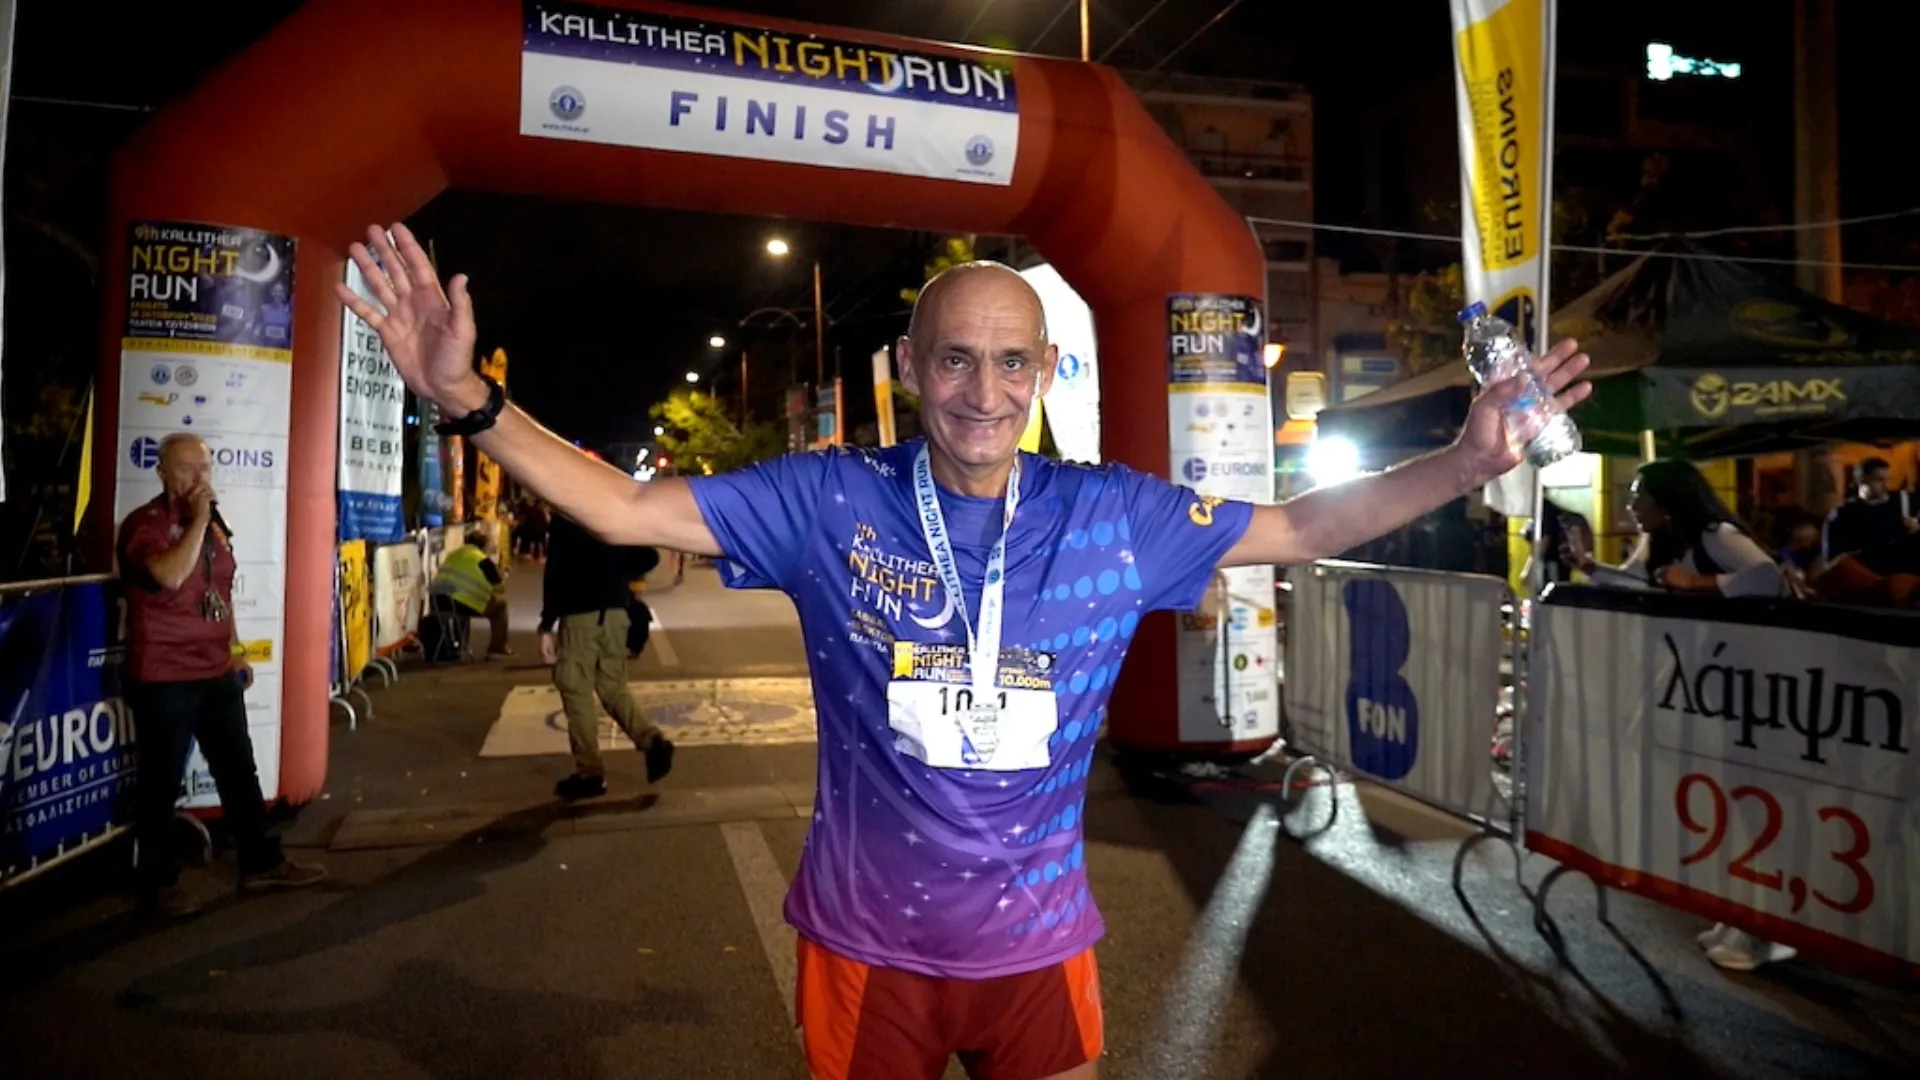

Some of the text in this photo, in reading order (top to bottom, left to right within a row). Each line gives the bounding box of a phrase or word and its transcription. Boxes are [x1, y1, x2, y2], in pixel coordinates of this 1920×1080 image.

[541, 11, 1006, 101] KALLITHEA NIGHT RUN
[669, 90, 896, 151] FINISH
[161, 228, 242, 247] KALLITHEA
[131, 244, 240, 276] NIGHT
[130, 272, 198, 302] RUN
[1171, 311, 1246, 334] NIGHT
[1171, 335, 1224, 354] RUN
[210, 447, 274, 468] OINS
[917, 458, 930, 491] RUN
[856, 523, 877, 541] th
[849, 549, 937, 602] NIGHT
[913, 653, 964, 668] NIGHT
[913, 667, 946, 680] RUN
[938, 686, 1007, 716] 101
[1657, 632, 1909, 764] λάμψη
[1357, 697, 1405, 745] FON
[10, 772, 73, 804] EMBER
[1674, 772, 1876, 915] 92,3
